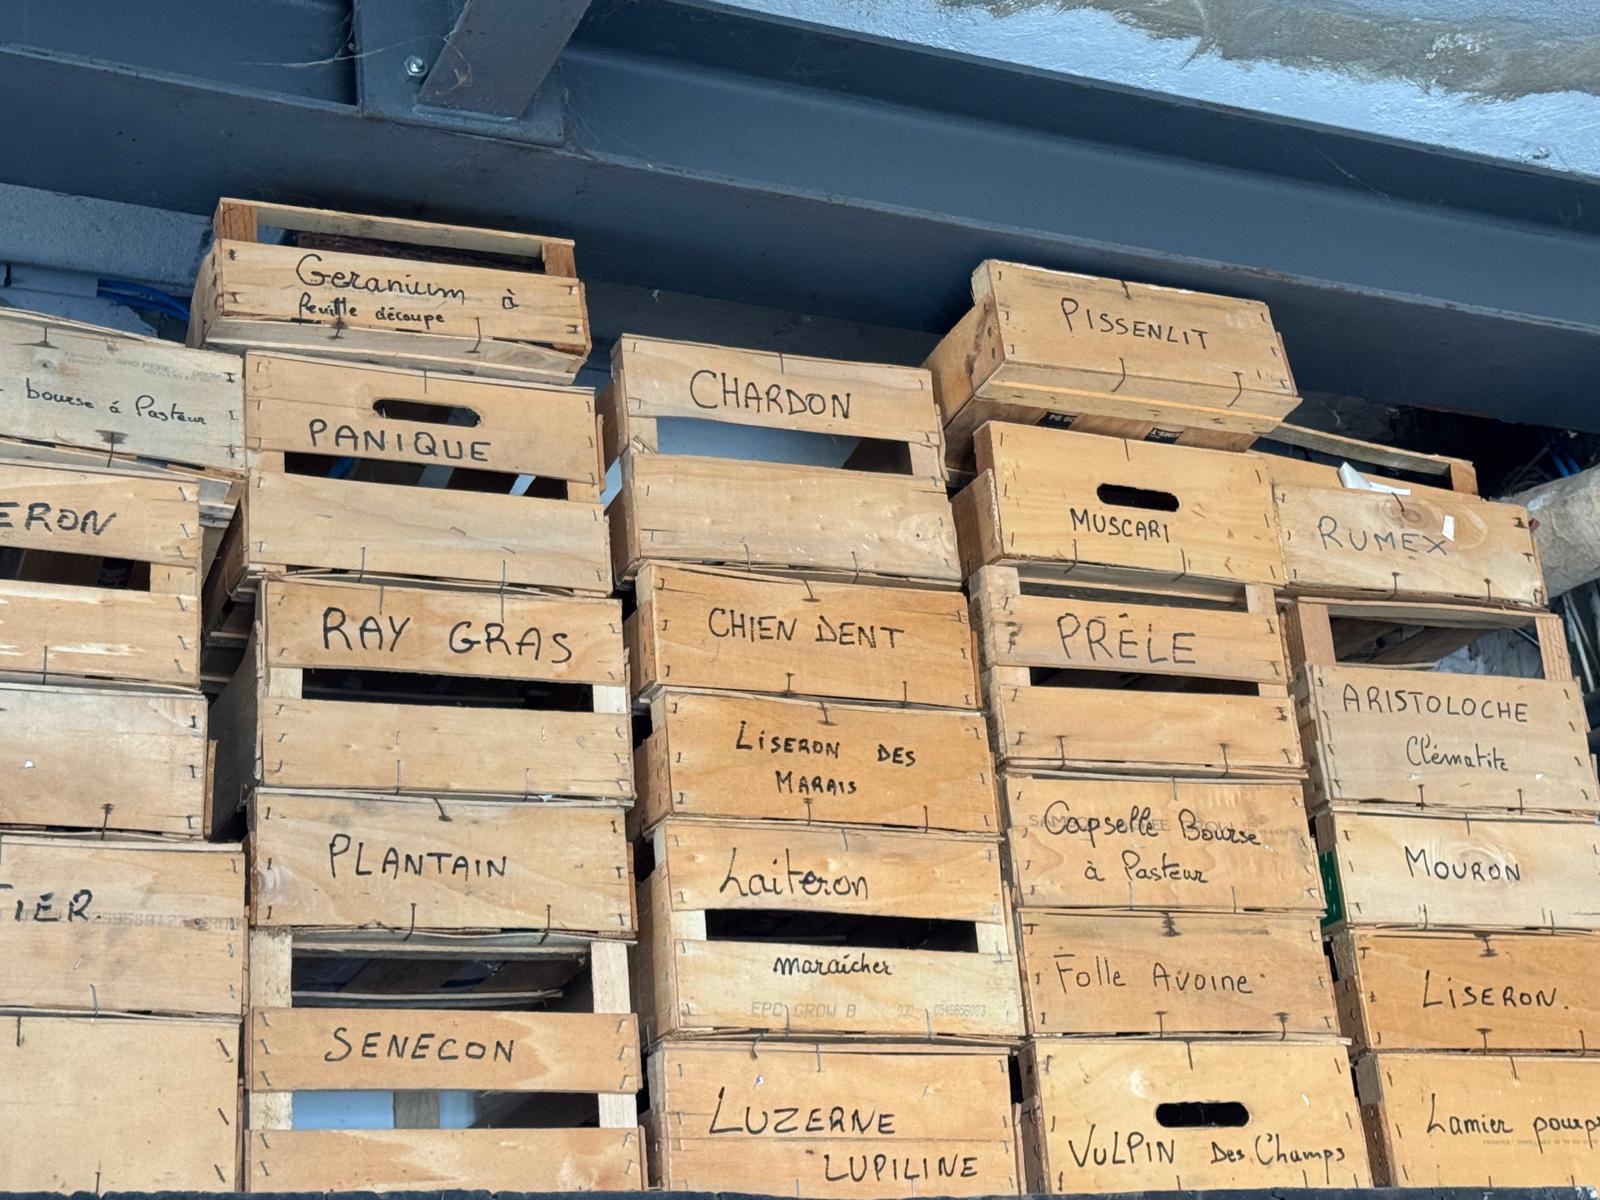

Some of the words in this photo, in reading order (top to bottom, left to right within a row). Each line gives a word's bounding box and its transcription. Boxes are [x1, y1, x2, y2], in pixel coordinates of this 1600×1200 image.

[296, 253, 465, 304] Geranium
[1059, 295, 1210, 351] PISSENLIT
[25, 376, 95, 410] bourse
[134, 393, 208, 426] Pasteur
[690, 370, 851, 419] CHARDON
[309, 418, 491, 461] PANIQUE
[1068, 506, 1171, 545] MUSCARI
[1316, 514, 1450, 557] RUMEX
[322, 606, 412, 654] RAY
[448, 620, 574, 665] GRAS
[707, 606, 799, 644] CHIEN
[814, 615, 906, 650] DENT
[1342, 682, 1530, 725] ARISTOLOCHE
[876, 743, 917, 768] DES
[1405, 733, 1510, 773] Clématite
[774, 769, 858, 797] MARAIS
[1044, 798, 1159, 850] Capselle
[1178, 807, 1263, 847] Bourse
[329, 832, 508, 881] PLANTAIN
[718, 846, 870, 902] Laiteron
[1121, 849, 1210, 884] Pasteur
[1403, 845, 1522, 882] MOURON
[1052, 953, 1127, 995] Folle
[324, 1026, 516, 1065] SENECON
[708, 1086, 897, 1136] LUZERNE
[1426, 1091, 1515, 1137] Lamier
[823, 1153, 980, 1182] LUPILINE
